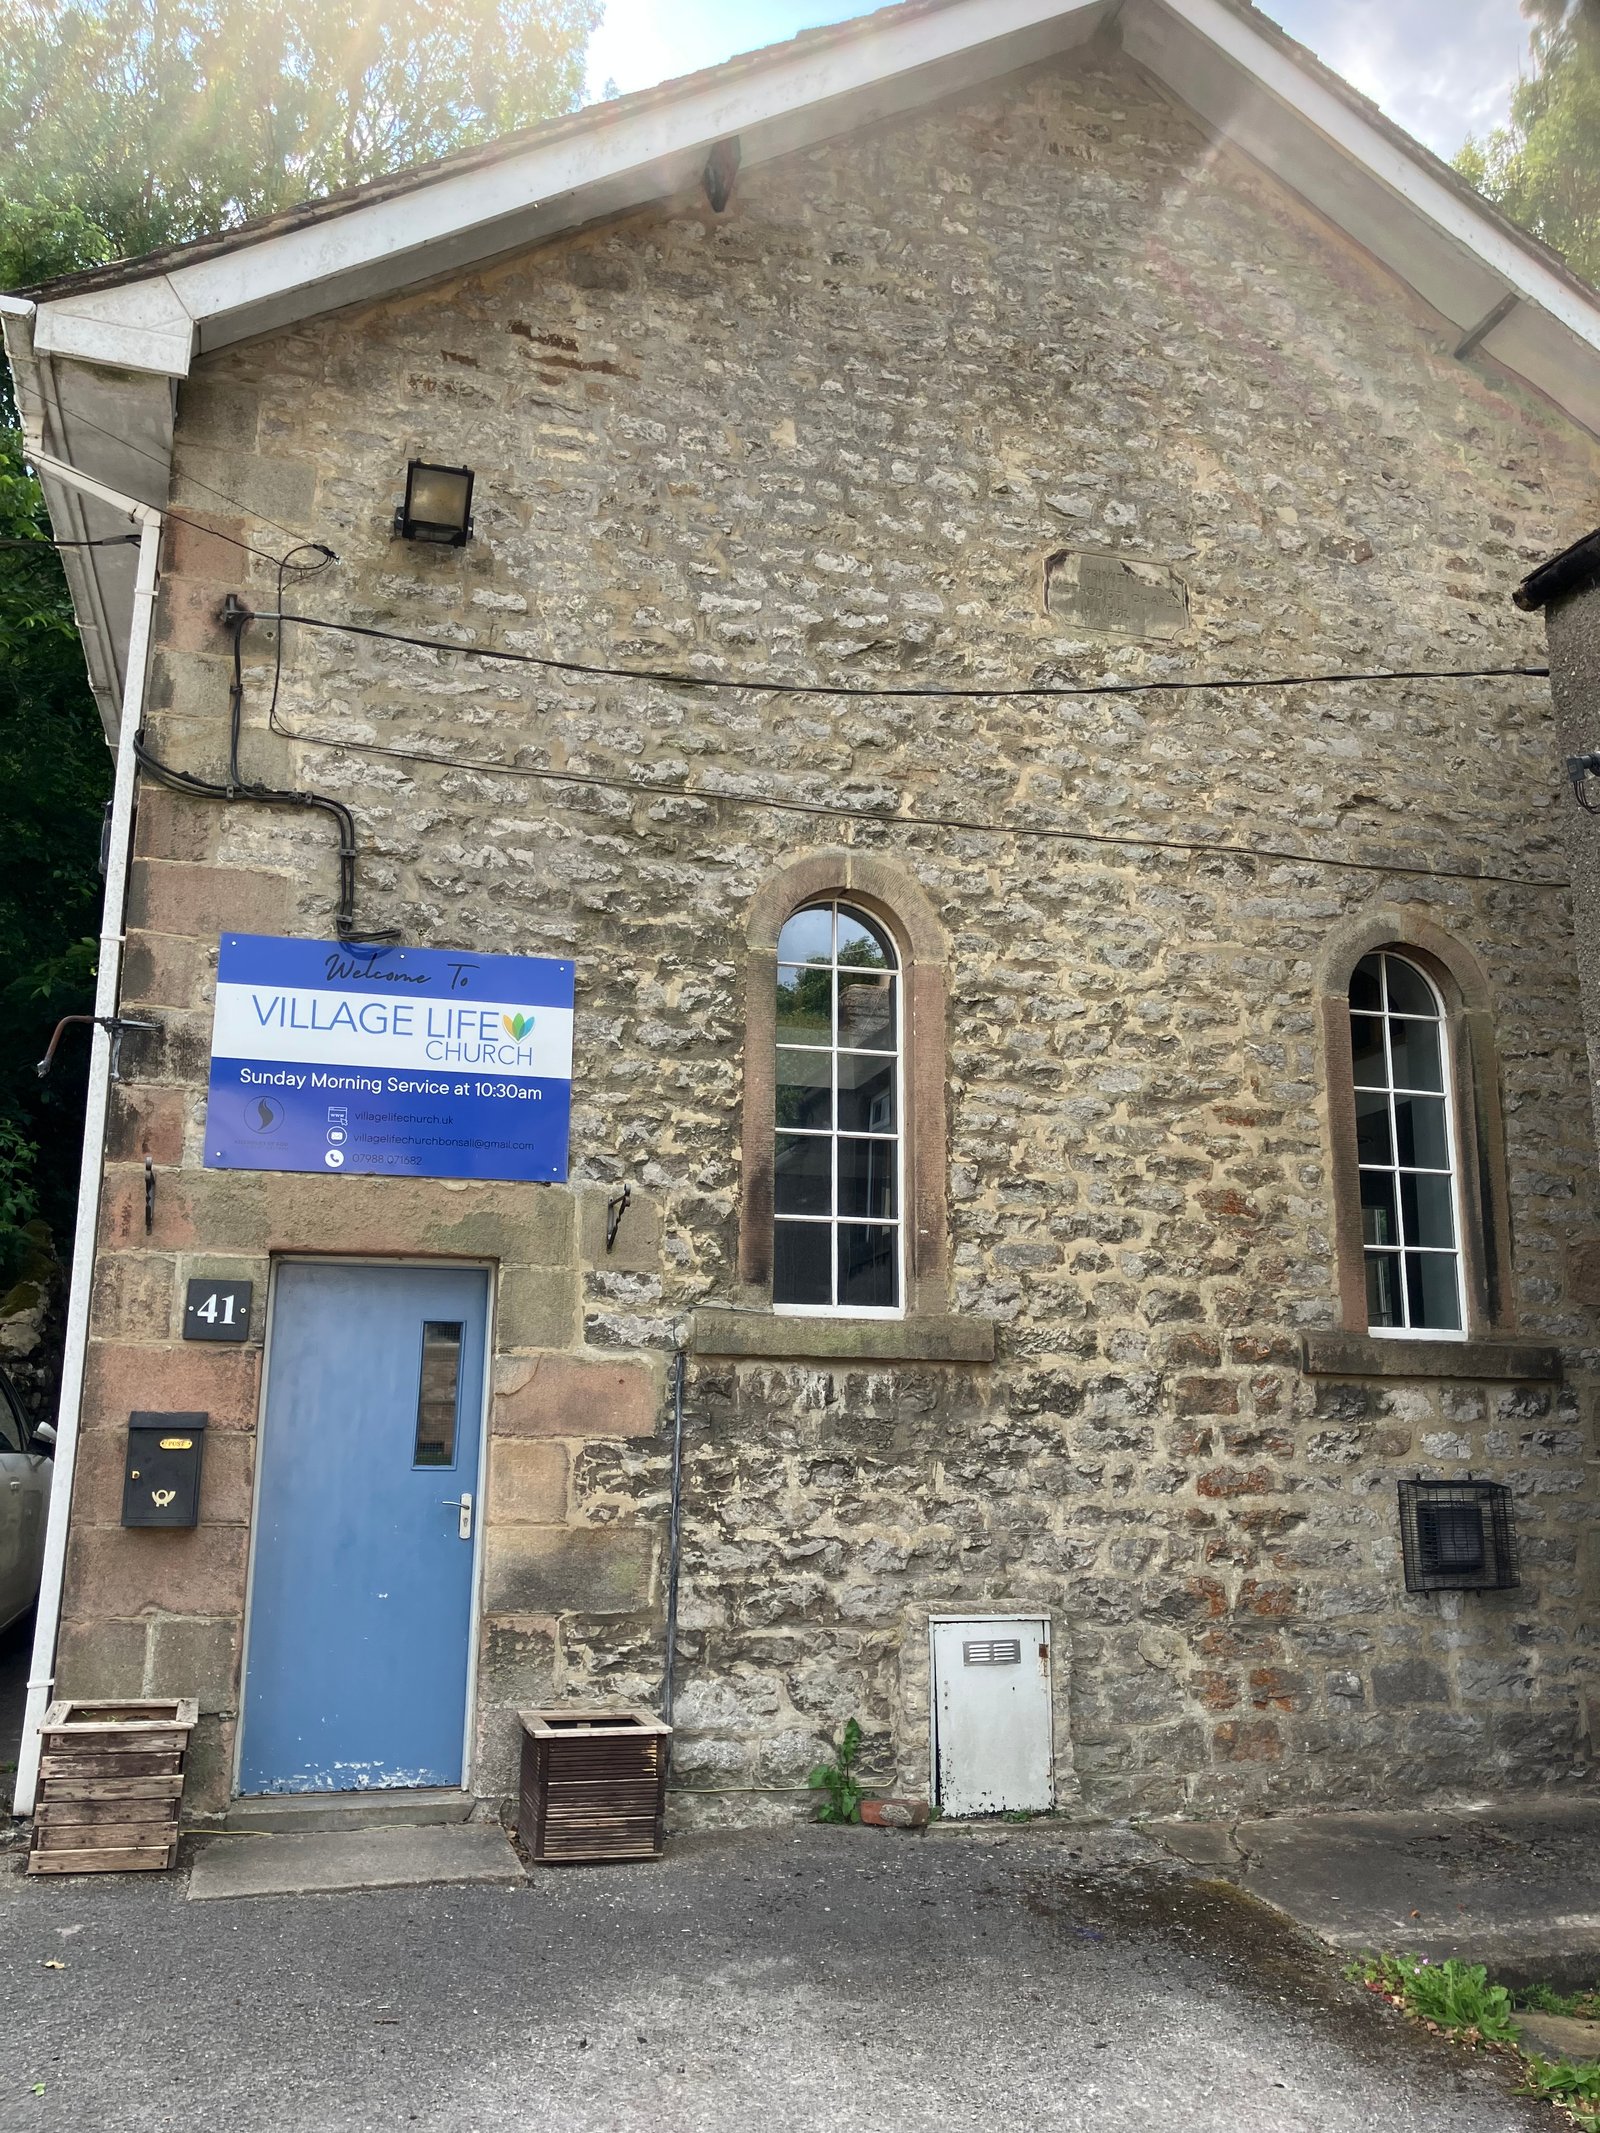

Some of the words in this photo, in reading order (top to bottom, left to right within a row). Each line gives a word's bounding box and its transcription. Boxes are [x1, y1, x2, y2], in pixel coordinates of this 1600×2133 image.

[325, 952, 431, 983] Welcome
[447, 963, 480, 990] To
[252, 994, 414, 1036] VILLAGE
[427, 1007, 499, 1042] LIFE
[425, 1040, 532, 1066] CHURCH
[240, 1067, 306, 1089] Sunday
[311, 1072, 382, 1095] Morning
[387, 1076, 450, 1094] Service
[453, 1082, 470, 1096] at
[474, 1082, 542, 1100] 10:30am
[354, 1111, 454, 1125] villagelifechurch.uk
[352, 1152, 384, 1164] 07988
[197, 1293, 236, 1325] 41
